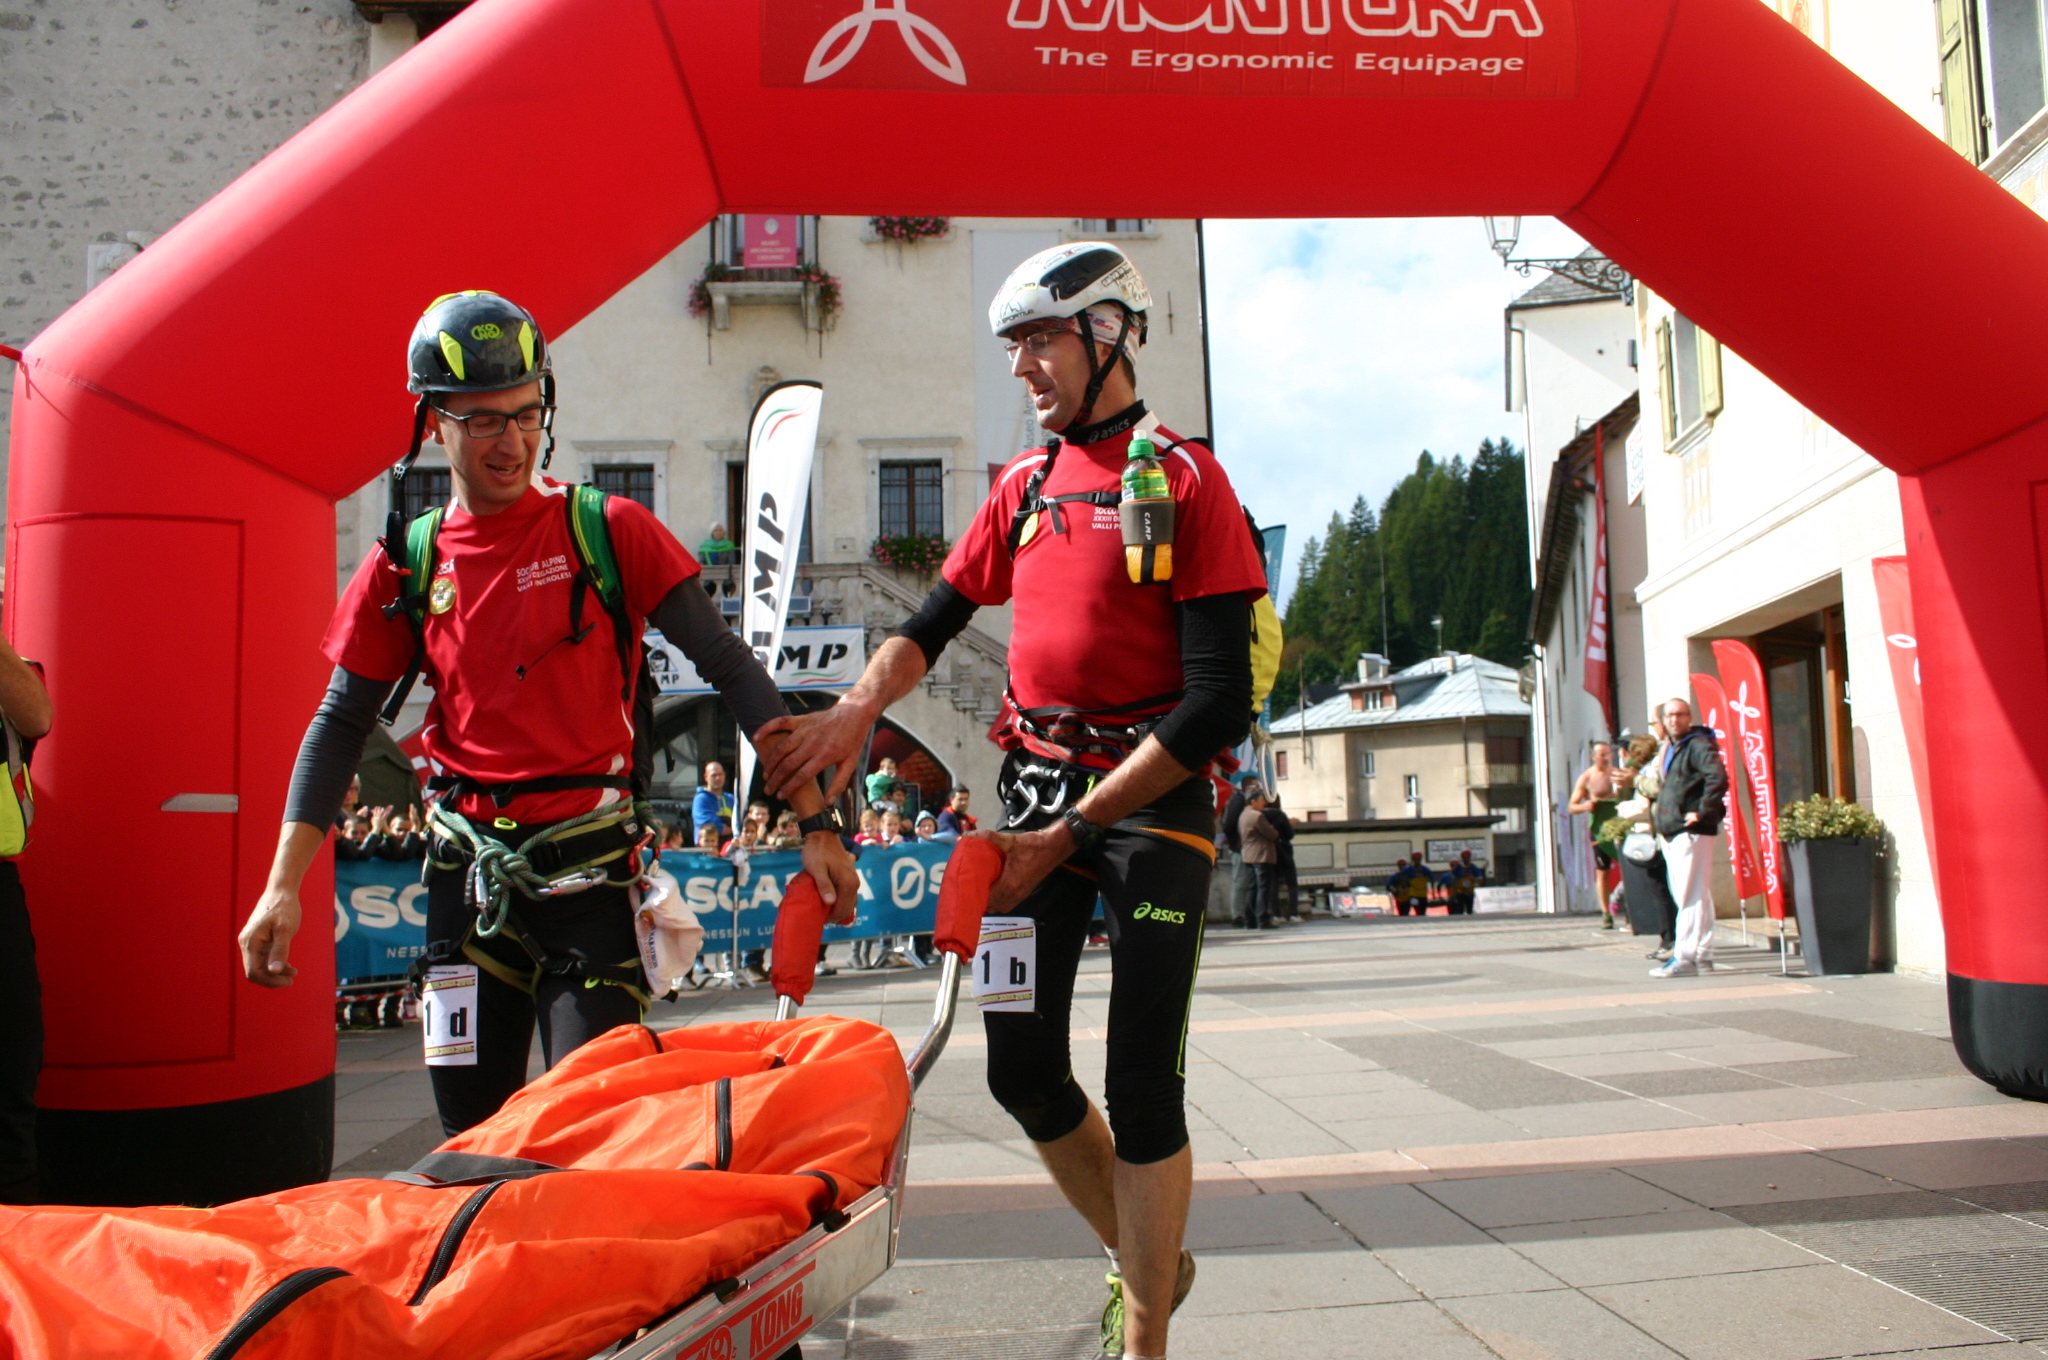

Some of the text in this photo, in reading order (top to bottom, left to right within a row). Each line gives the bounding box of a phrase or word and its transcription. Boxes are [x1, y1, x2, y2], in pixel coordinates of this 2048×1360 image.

[1034, 47, 1524, 76] The Ergonomic Equipage
[1101, 418, 1130, 439] asics
[1091, 522, 1112, 530] VALLI
[1144, 512, 1152, 541] CAMP
[541, 554, 566, 569] ALPINO
[776, 643, 848, 670] MP
[1150, 907, 1186, 924] asics
[982, 950, 1027, 986] 1 b
[425, 1000, 468, 1038] 1 d
[750, 1281, 804, 1357] KONG
